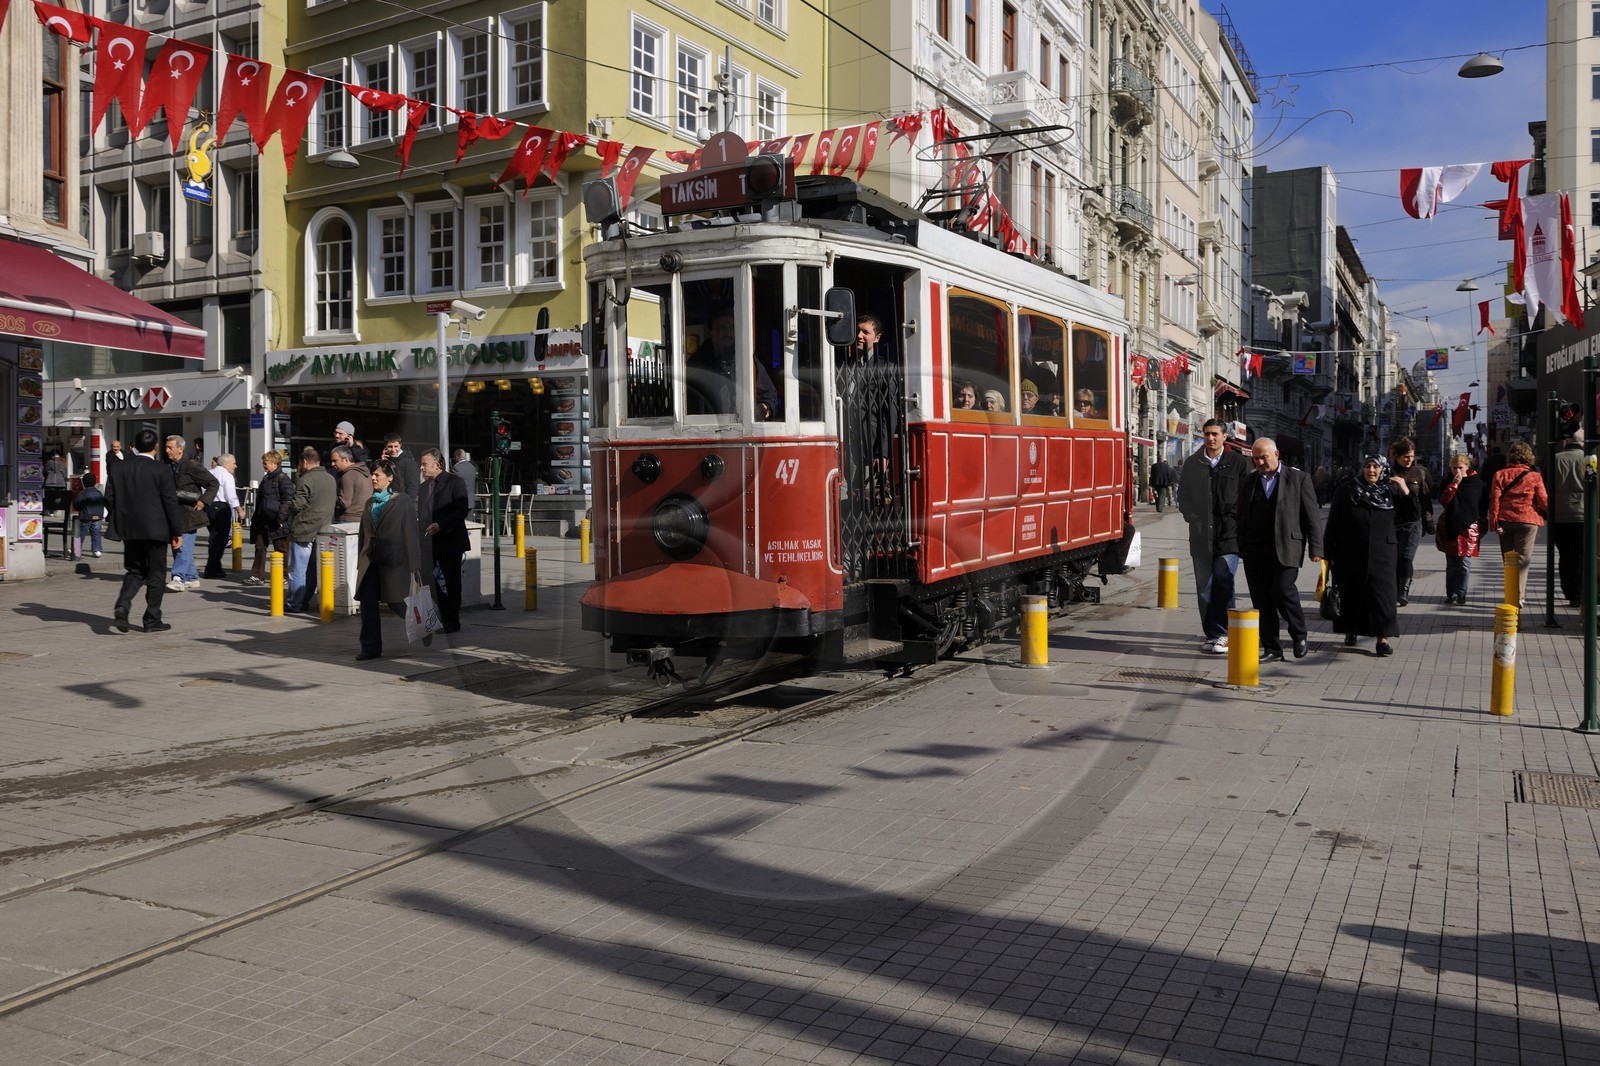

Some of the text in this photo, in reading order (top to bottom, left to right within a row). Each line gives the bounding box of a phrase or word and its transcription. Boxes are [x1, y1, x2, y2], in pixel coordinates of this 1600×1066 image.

[719, 138, 727, 161] 1
[669, 176, 718, 203] TAKSİM
[38, 322, 56, 333] 7/24
[311, 349, 398, 375] AYVALIK
[546, 339, 581, 358] UMPİR
[93, 388, 142, 412] HSBC
[775, 459, 800, 485] 47
[802, 539, 822, 550] YASAK
[764, 552, 774, 563] VE
